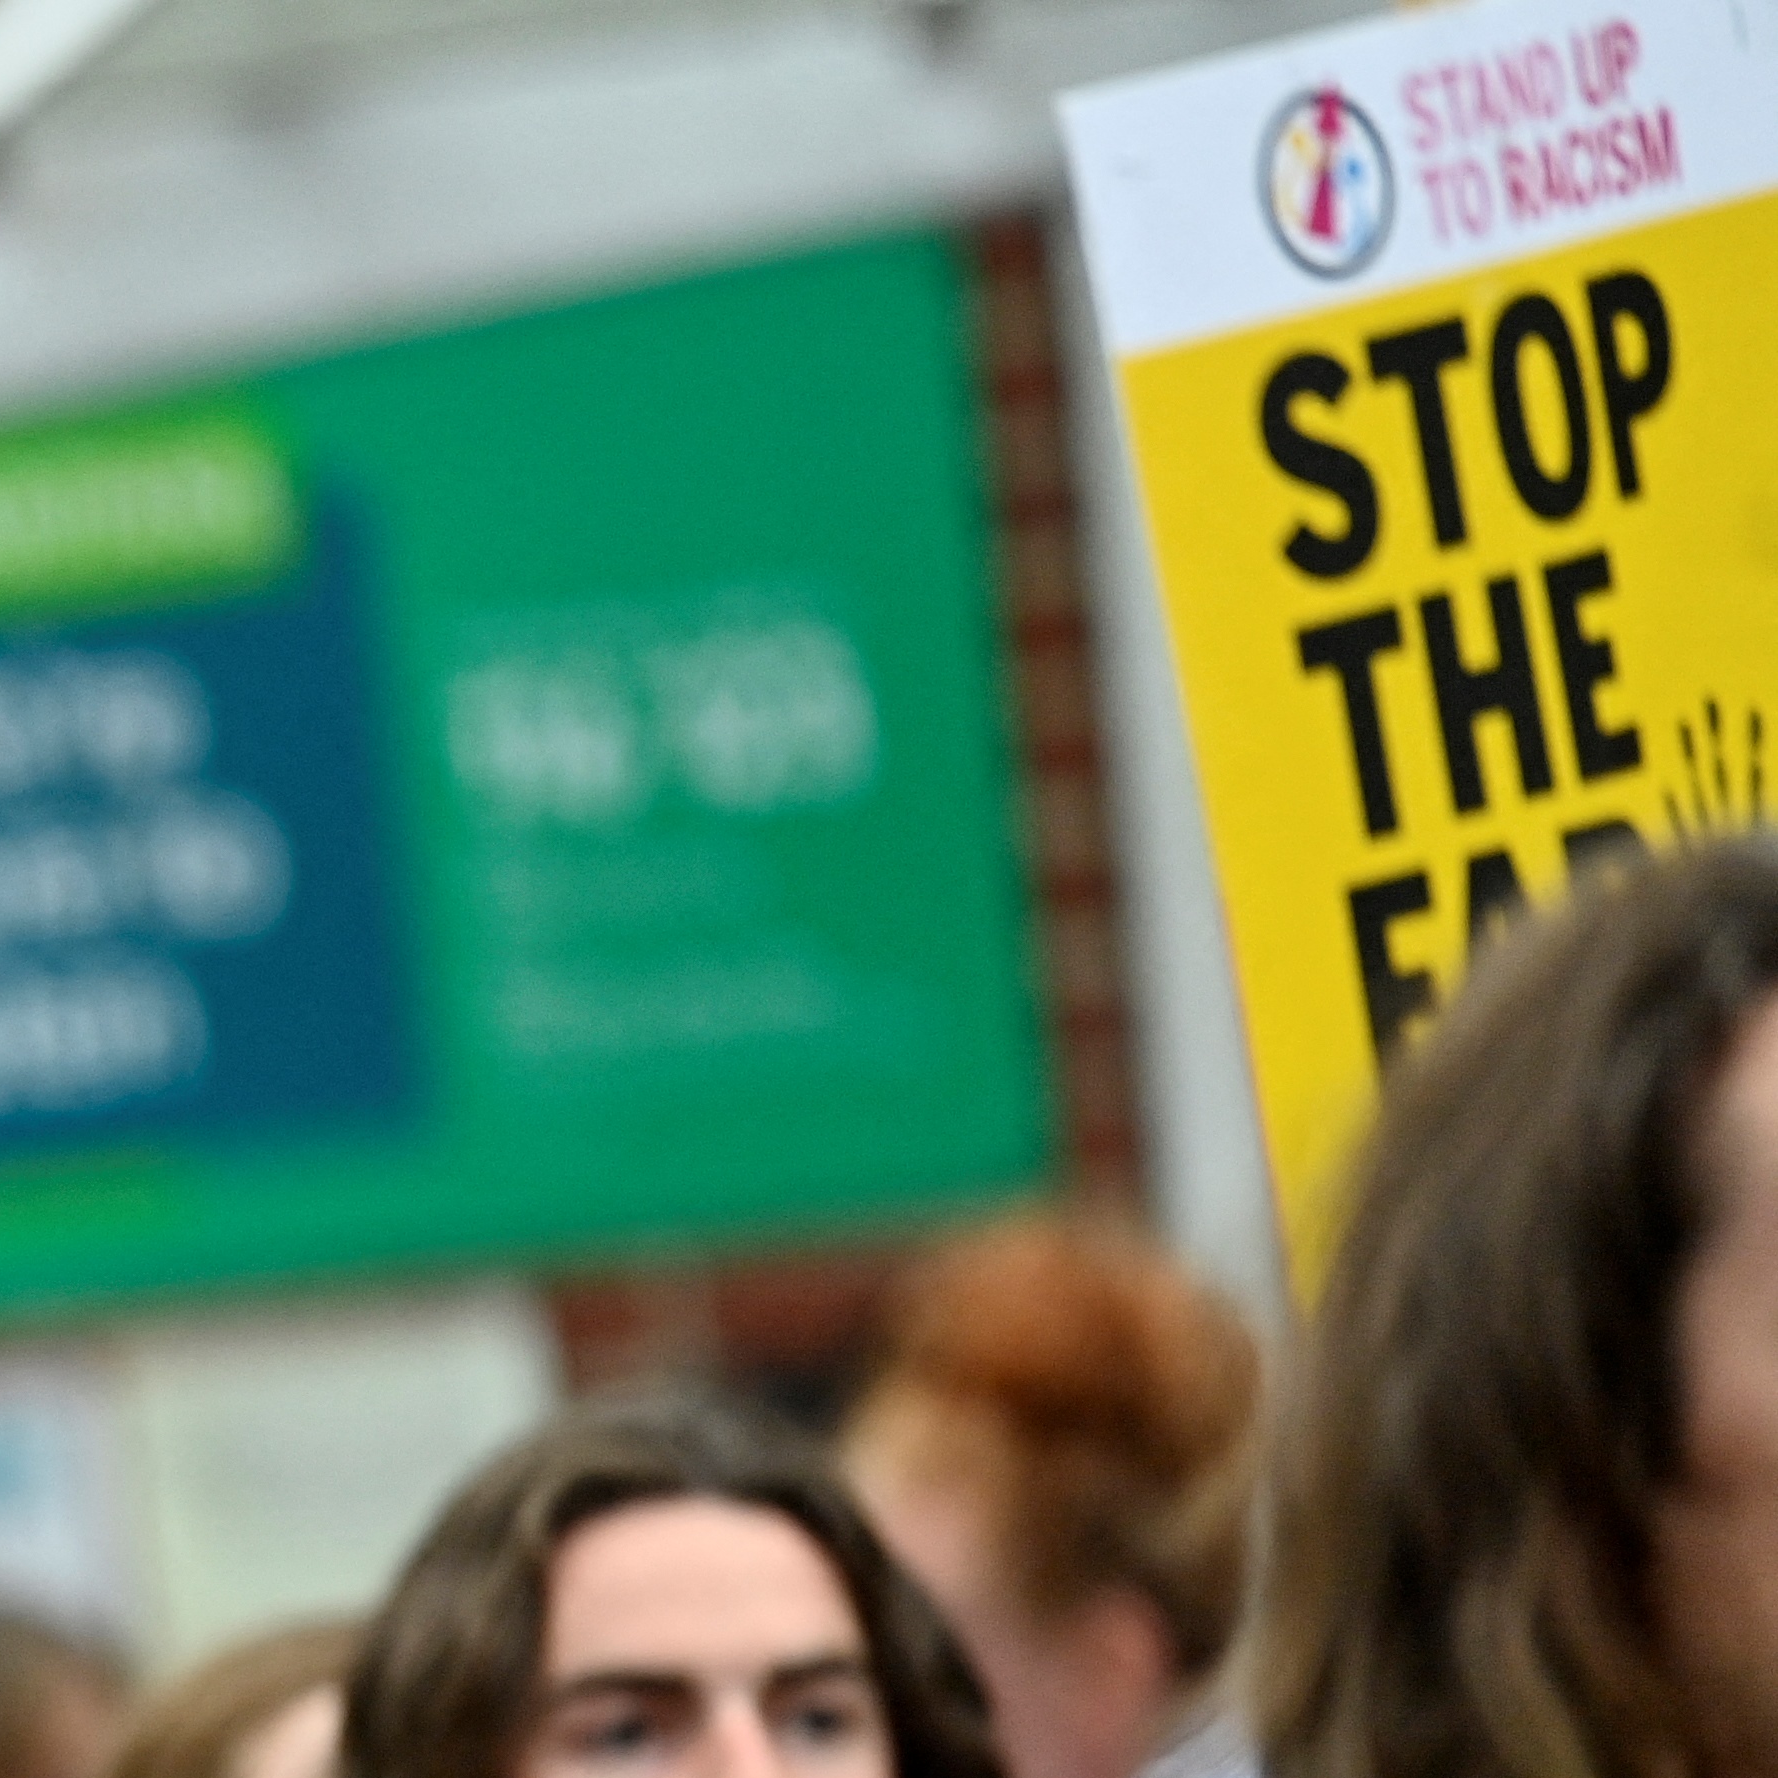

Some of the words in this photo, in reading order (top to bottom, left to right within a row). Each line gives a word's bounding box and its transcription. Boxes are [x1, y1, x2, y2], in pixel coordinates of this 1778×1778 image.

[1400, 38, 1567, 152] STAND
[1567, 16, 1641, 108] UP
[1420, 155, 1495, 248] TO
[1497, 102, 1683, 224] RACISM
[1259, 268, 1673, 580] STOP
[1295, 548, 1643, 842] THE
